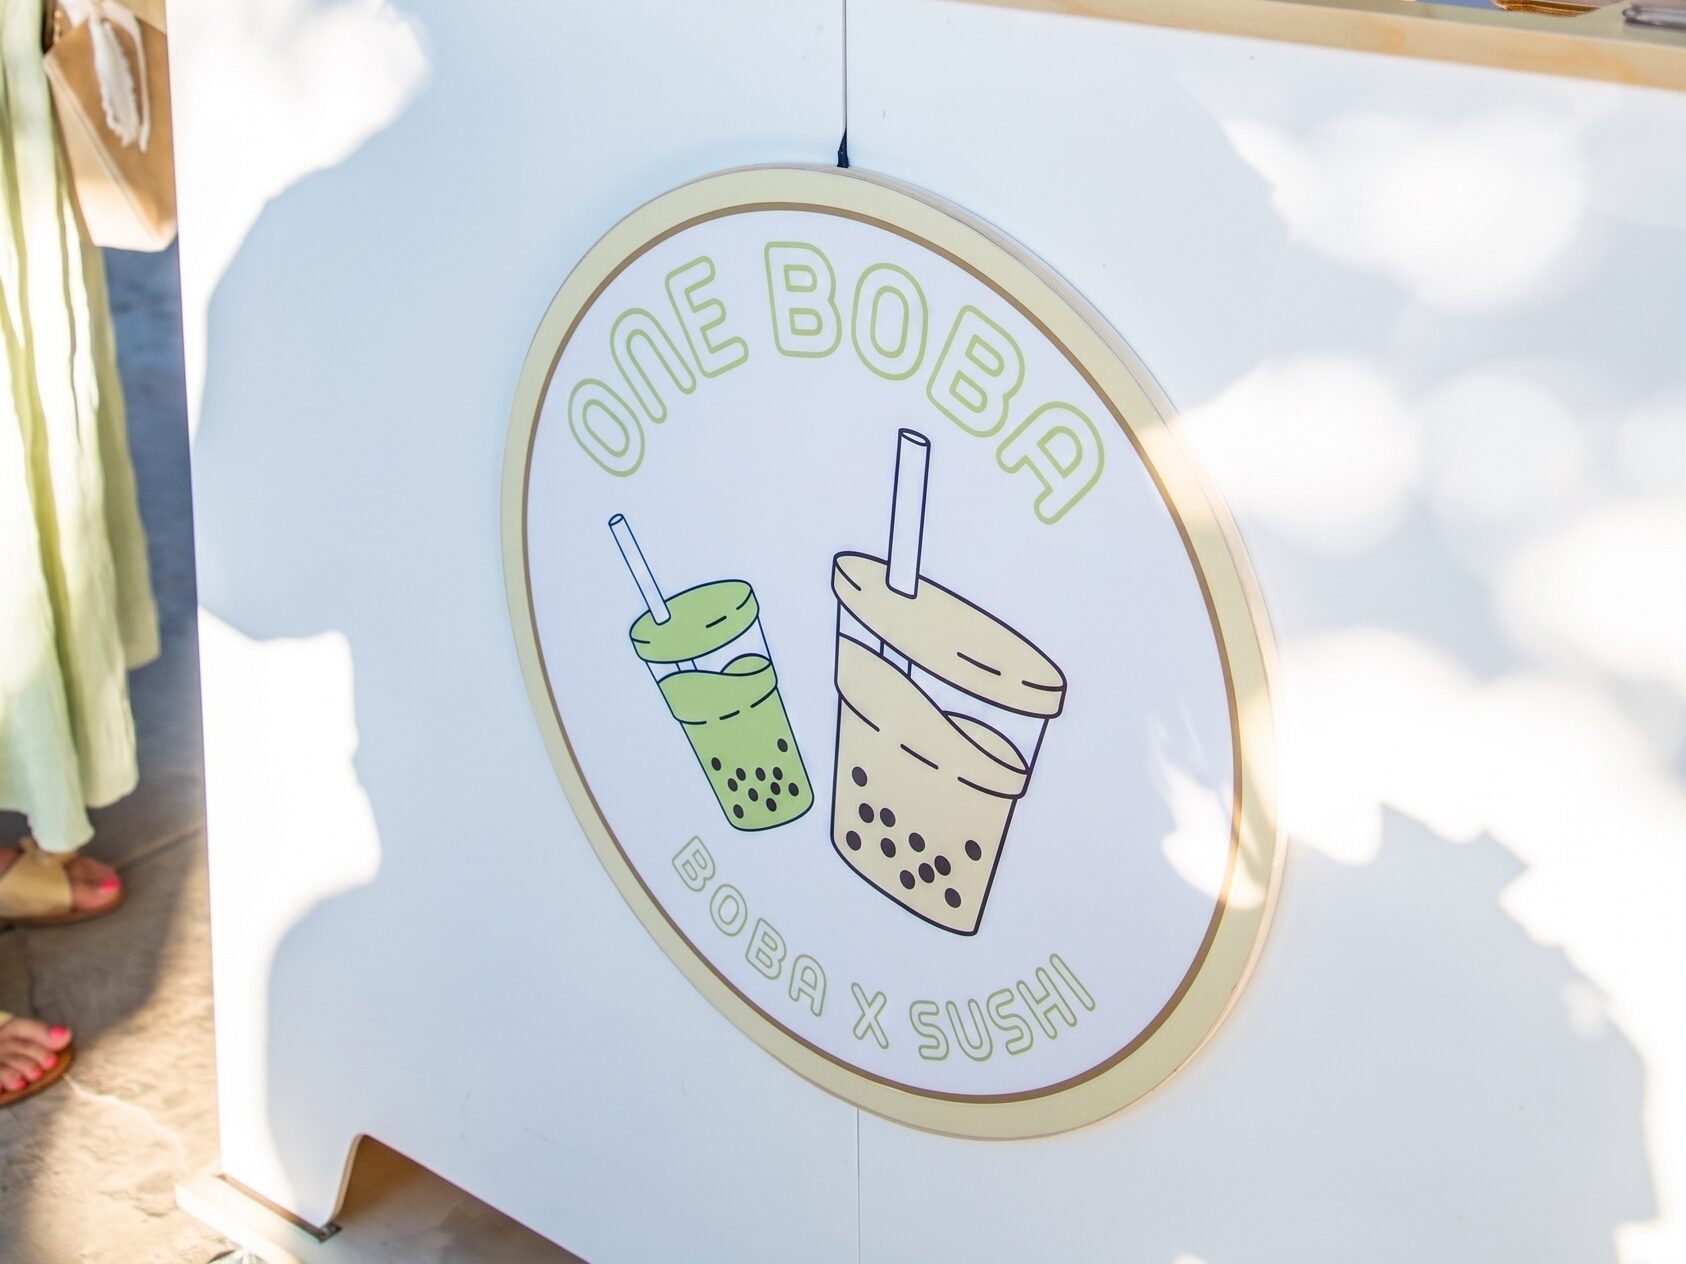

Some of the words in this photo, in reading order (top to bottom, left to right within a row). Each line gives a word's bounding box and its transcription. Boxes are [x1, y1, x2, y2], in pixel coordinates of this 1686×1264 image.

[567, 255, 749, 478] ONE
[764, 241, 1105, 526] BOBA
[671, 835, 827, 1018] BOBA
[850, 982, 890, 1050] X
[908, 952, 1097, 1063] SUSHI
